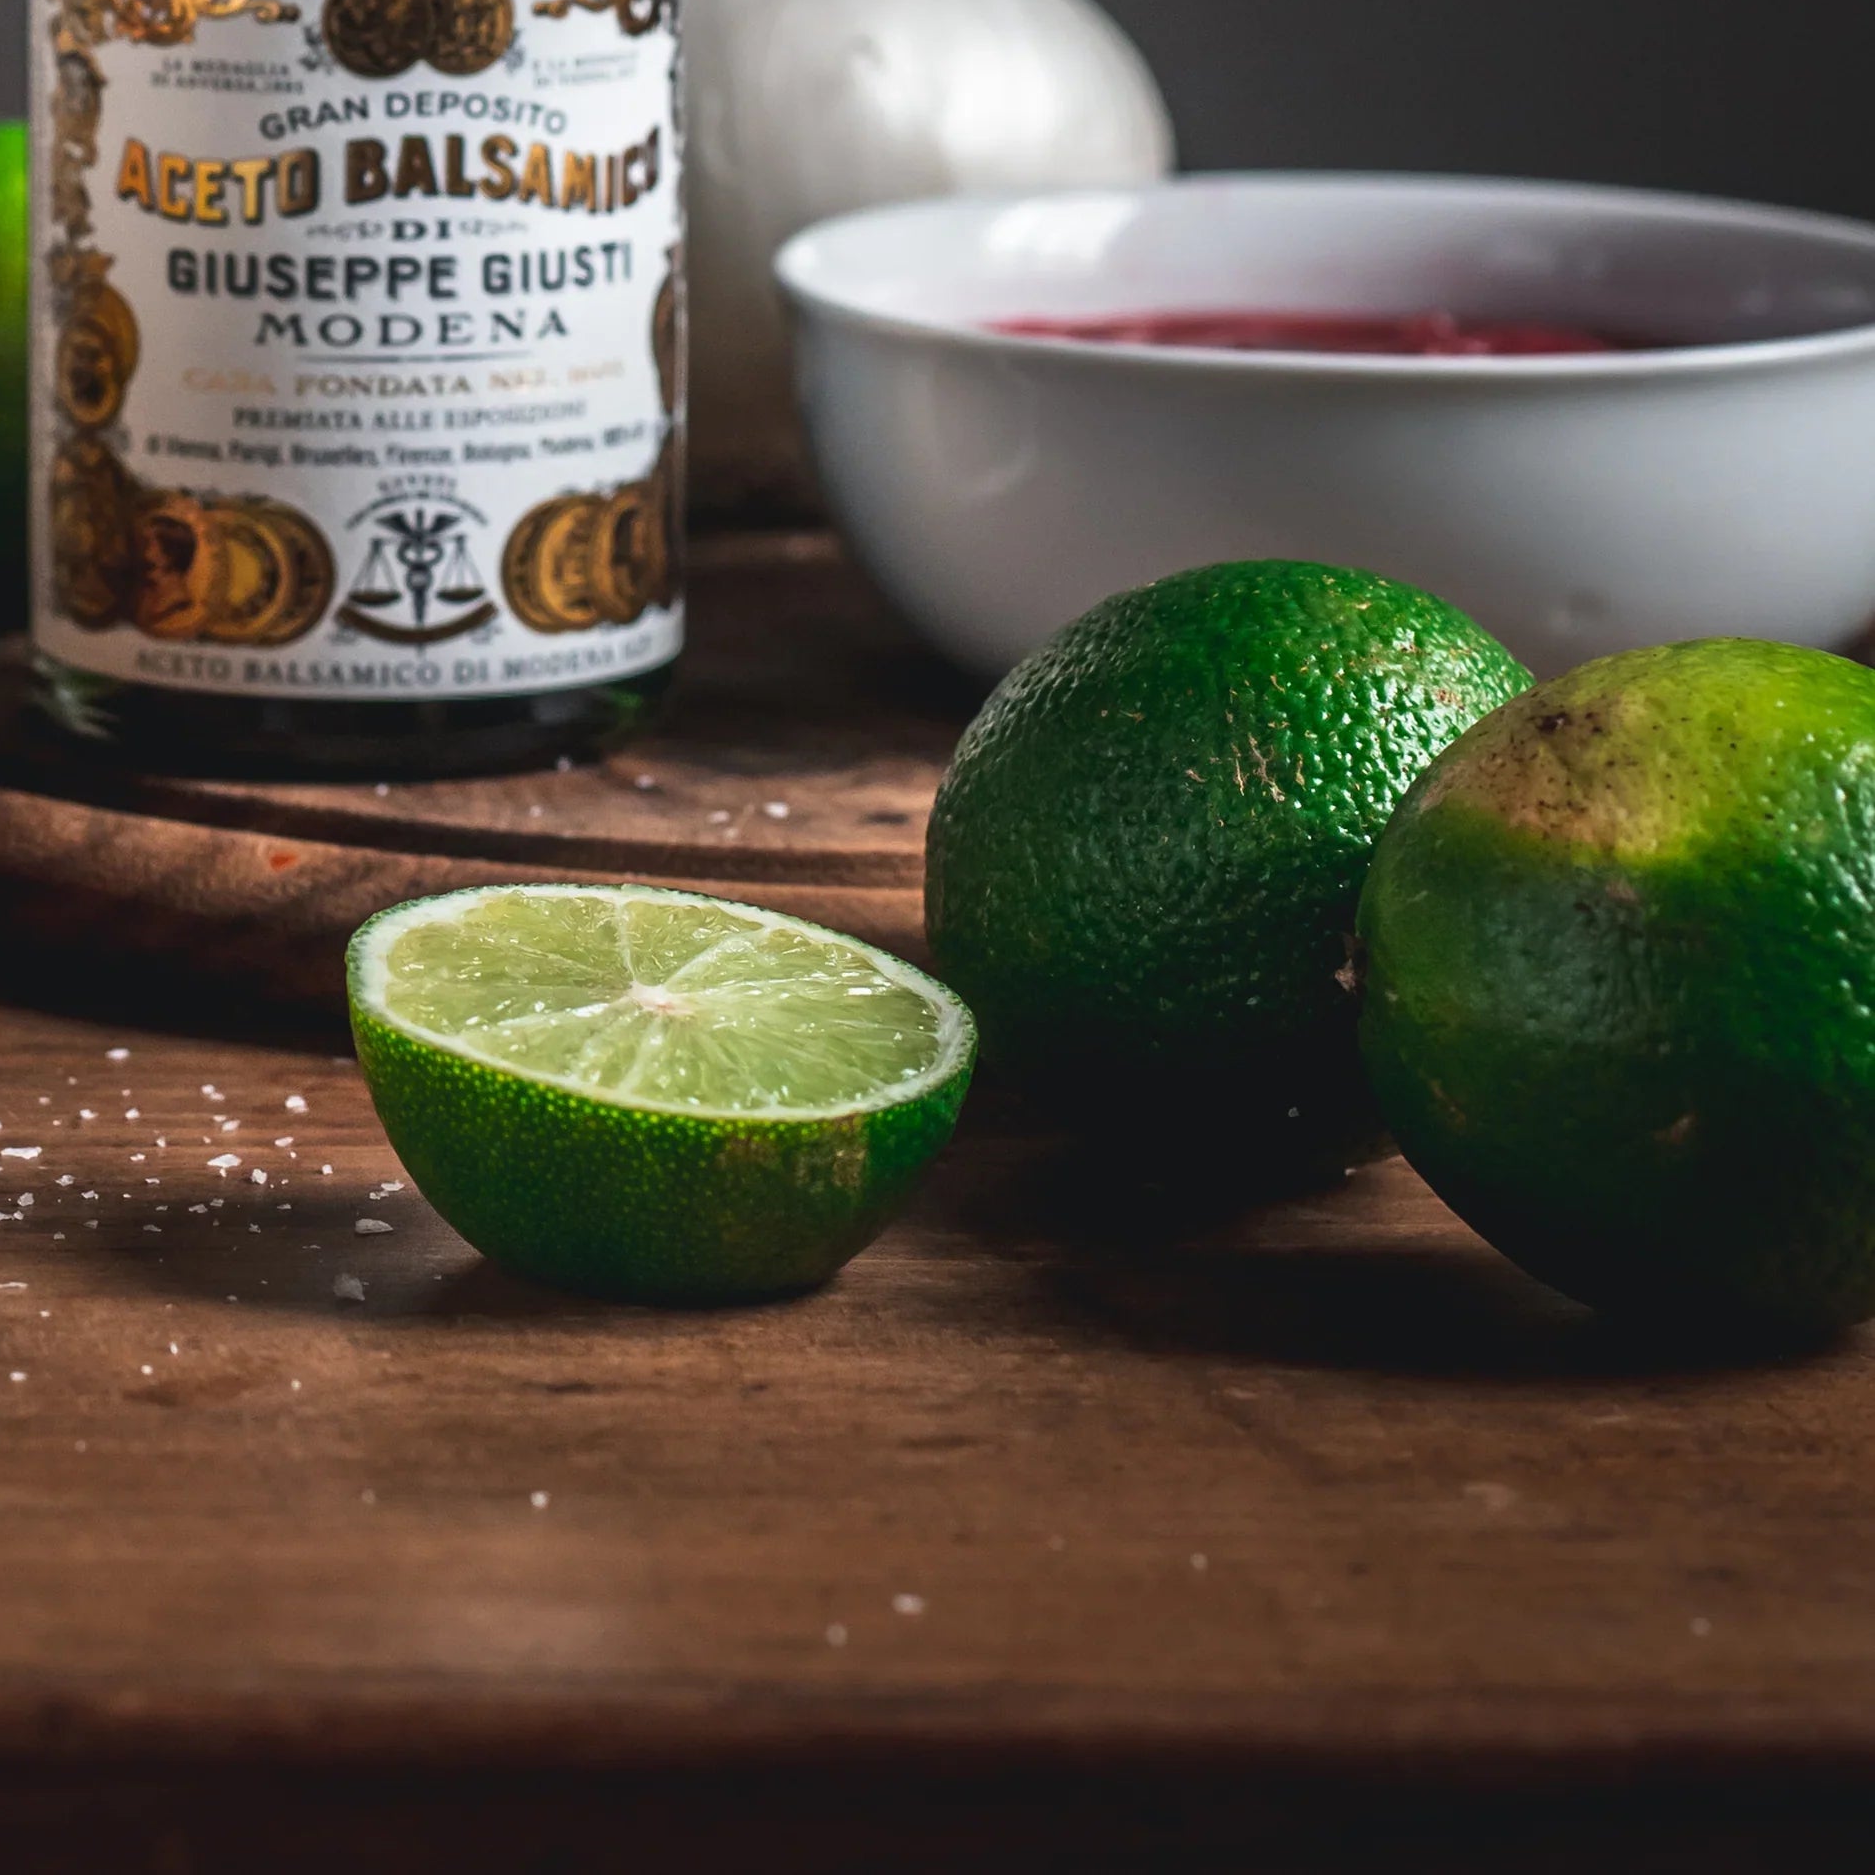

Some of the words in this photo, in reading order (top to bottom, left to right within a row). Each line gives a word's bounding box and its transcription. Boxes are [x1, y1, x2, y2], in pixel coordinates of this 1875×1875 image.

[258, 95, 369, 140] GRAN
[385, 91, 568, 135] DEPOSITO
[117, 137, 320, 227] ACETO
[345, 123, 660, 215] BALSAMICO
[392, 220, 451, 241] DI
[167, 246, 457, 301] GIUSEPPE
[481, 241, 632, 296] GIUSTI
[254, 309, 568, 348] MODENA
[294, 372, 471, 397] FONDATA
[232, 407, 362, 430] PREMIATA
[373, 410, 433, 431] ALLE
[136, 650, 231, 679] ACETO
[242, 658, 441, 688] BALSAMICO
[453, 657, 489, 686] DI
